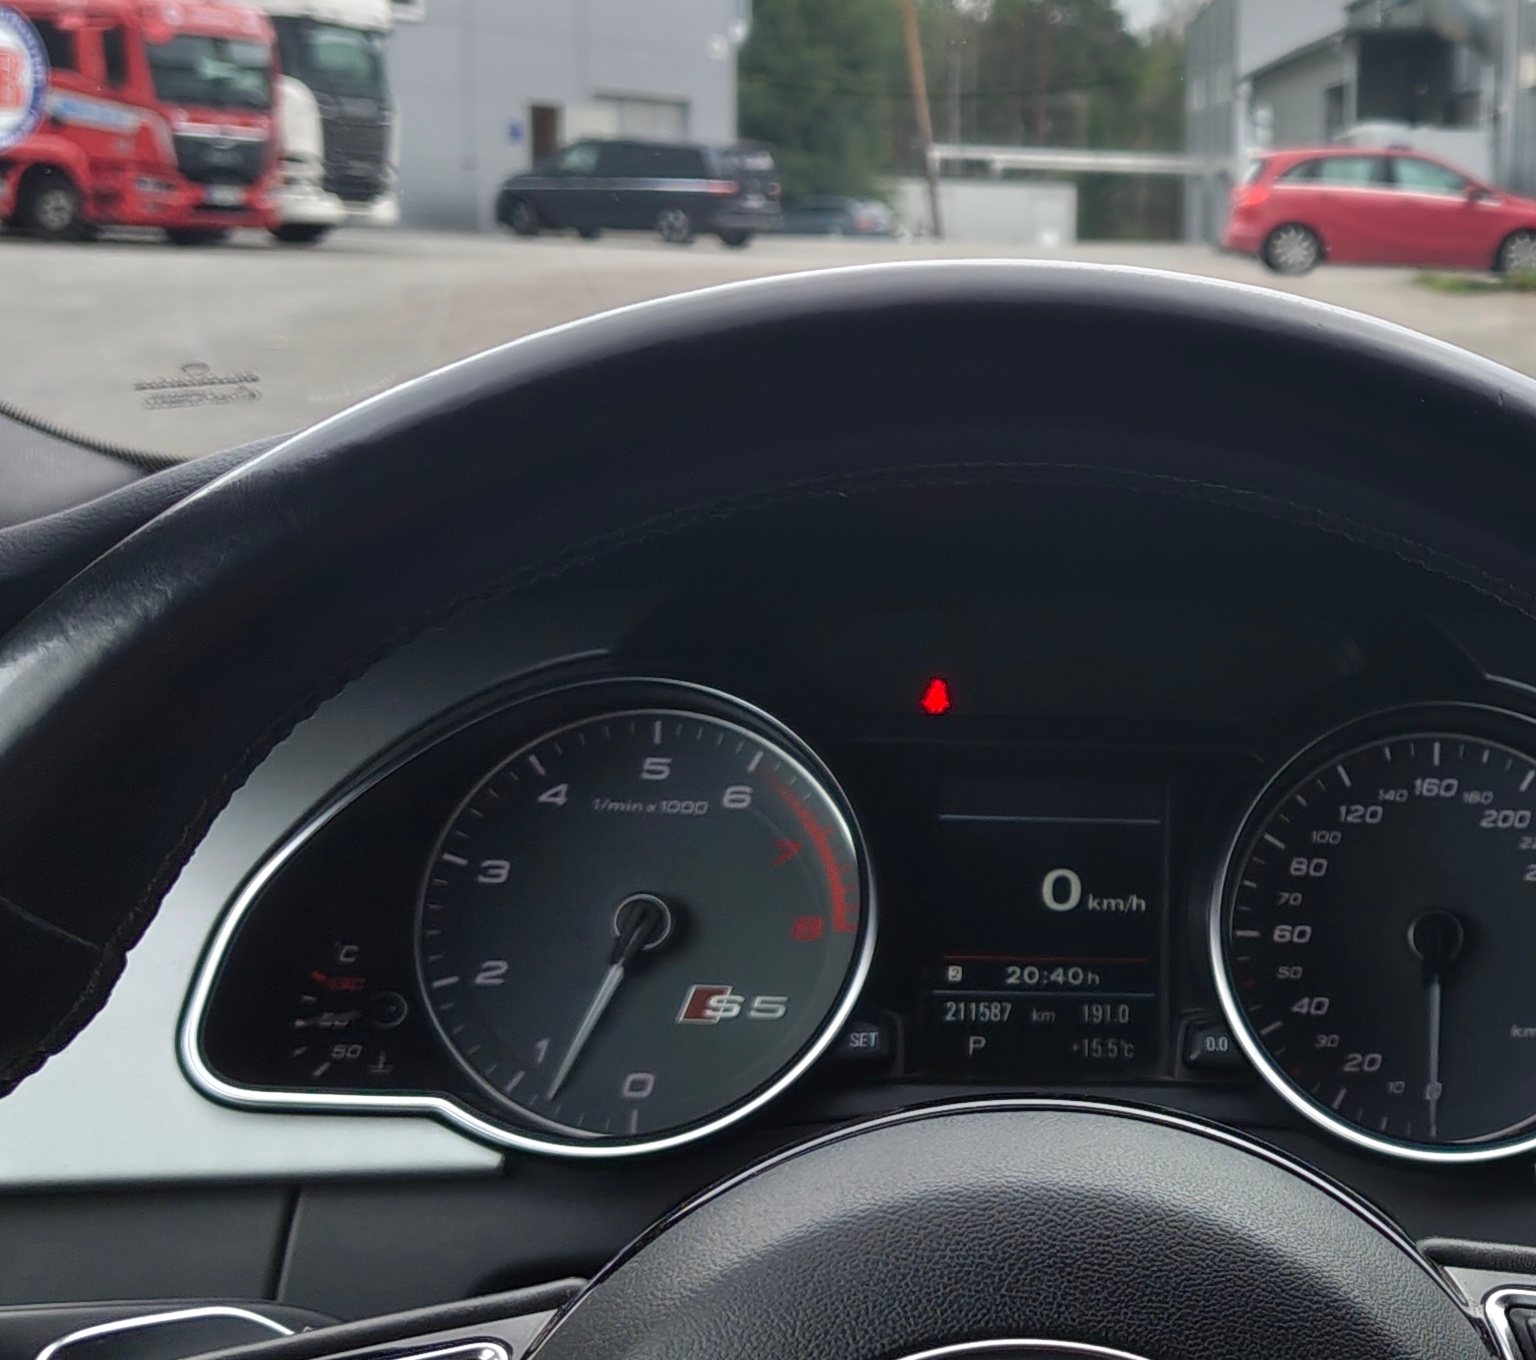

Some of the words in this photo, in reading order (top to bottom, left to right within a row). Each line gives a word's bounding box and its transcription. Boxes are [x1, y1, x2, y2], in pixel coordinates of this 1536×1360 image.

[641, 757, 671, 780] 5
[538, 783, 569, 807] 4
[722, 786, 753, 809] 6
[1378, 788, 1408, 803] 140
[1414, 778, 1459, 798] 160
[1339, 805, 1383, 824] 120
[1479, 810, 1532, 829] 200
[1311, 830, 1342, 845] 100
[478, 860, 511, 884] 3
[1289, 858, 1328, 877] 80
[1042, 868, 1081, 911] 0
[1087, 894, 1146, 913] km/h
[1277, 892, 1303, 907] 70
[1273, 925, 1312, 944] 60
[475, 961, 508, 985] 2
[944, 1001, 1012, 1022] 211587
[1032, 1008, 1056, 1022] km
[1292, 997, 1329, 1016] 40
[849, 1031, 880, 1049] SET
[968, 1036, 986, 1055] P
[1343, 1053, 1382, 1072] 20
[621, 1073, 654, 1097] 0
